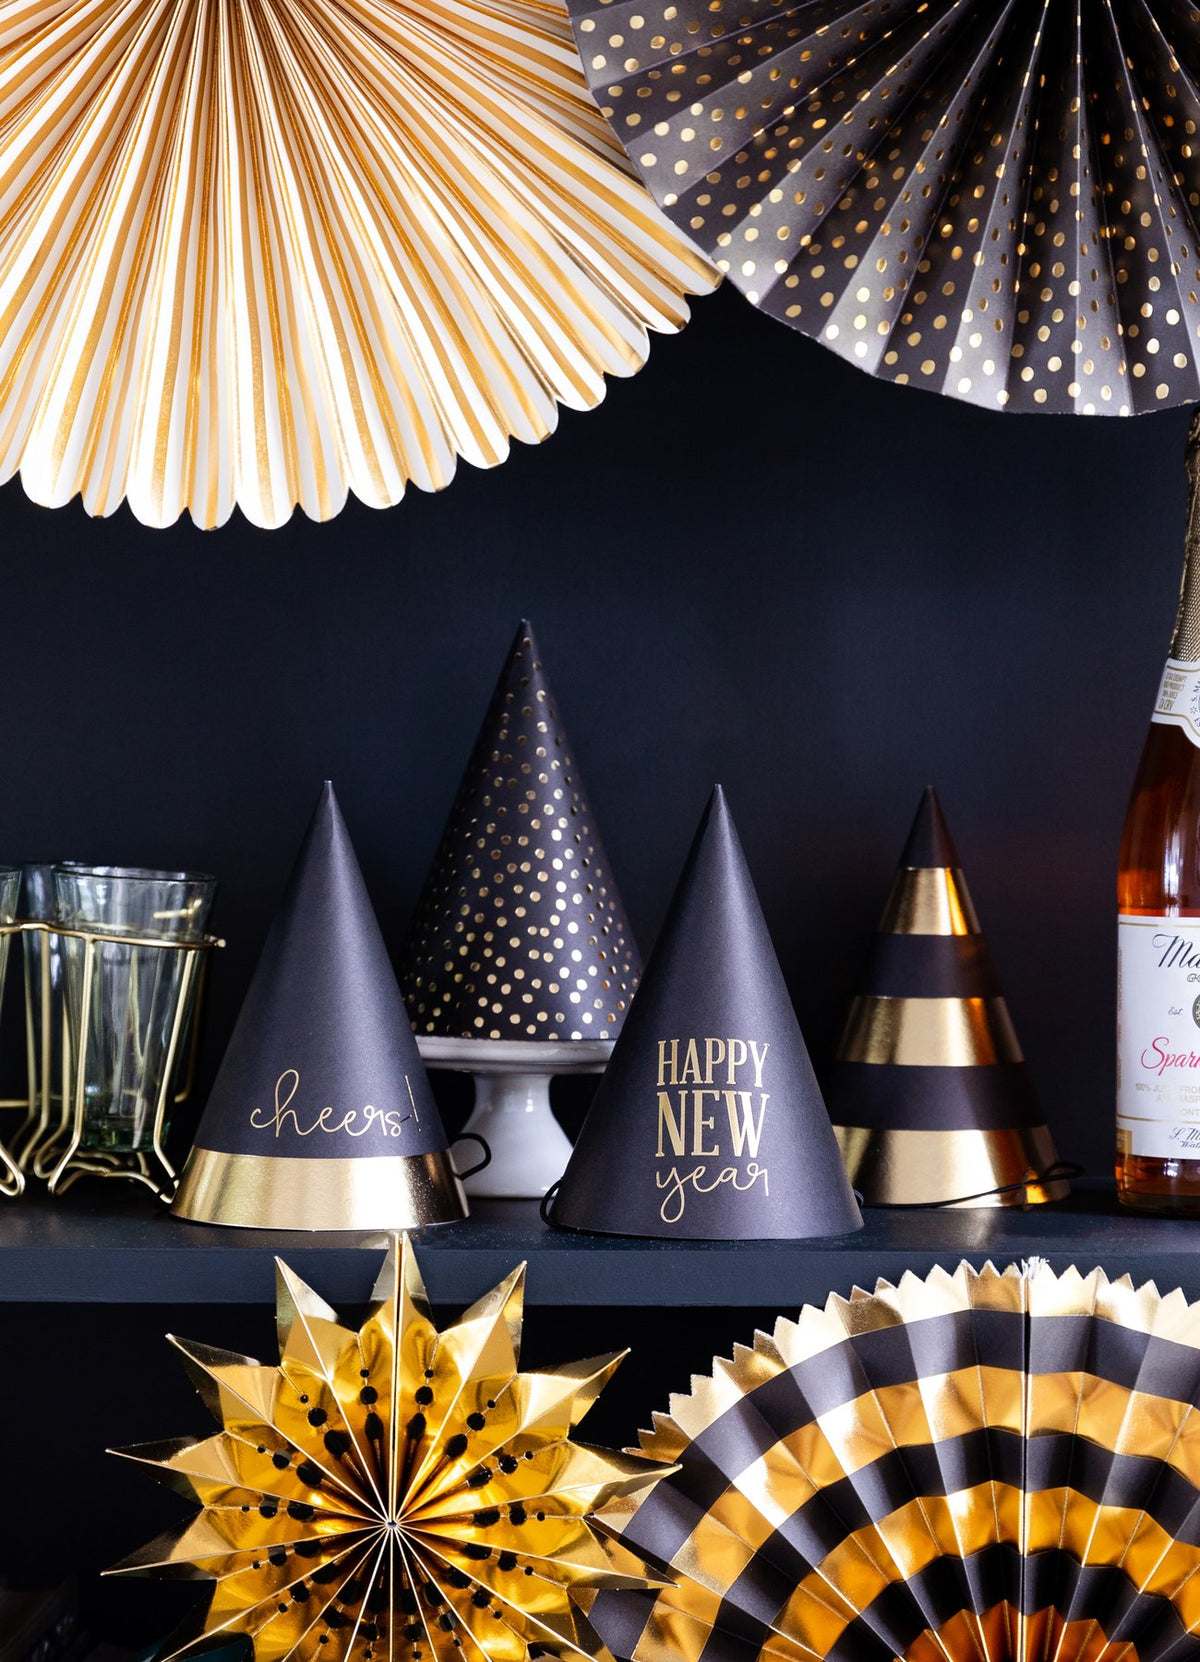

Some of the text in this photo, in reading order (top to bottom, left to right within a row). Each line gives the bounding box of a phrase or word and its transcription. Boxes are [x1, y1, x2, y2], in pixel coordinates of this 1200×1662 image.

[656, 1037, 771, 1088] HAPPY
[250, 1069, 423, 1138] cheers!
[655, 1089, 771, 1159] NEW
[656, 1162, 770, 1224] year
